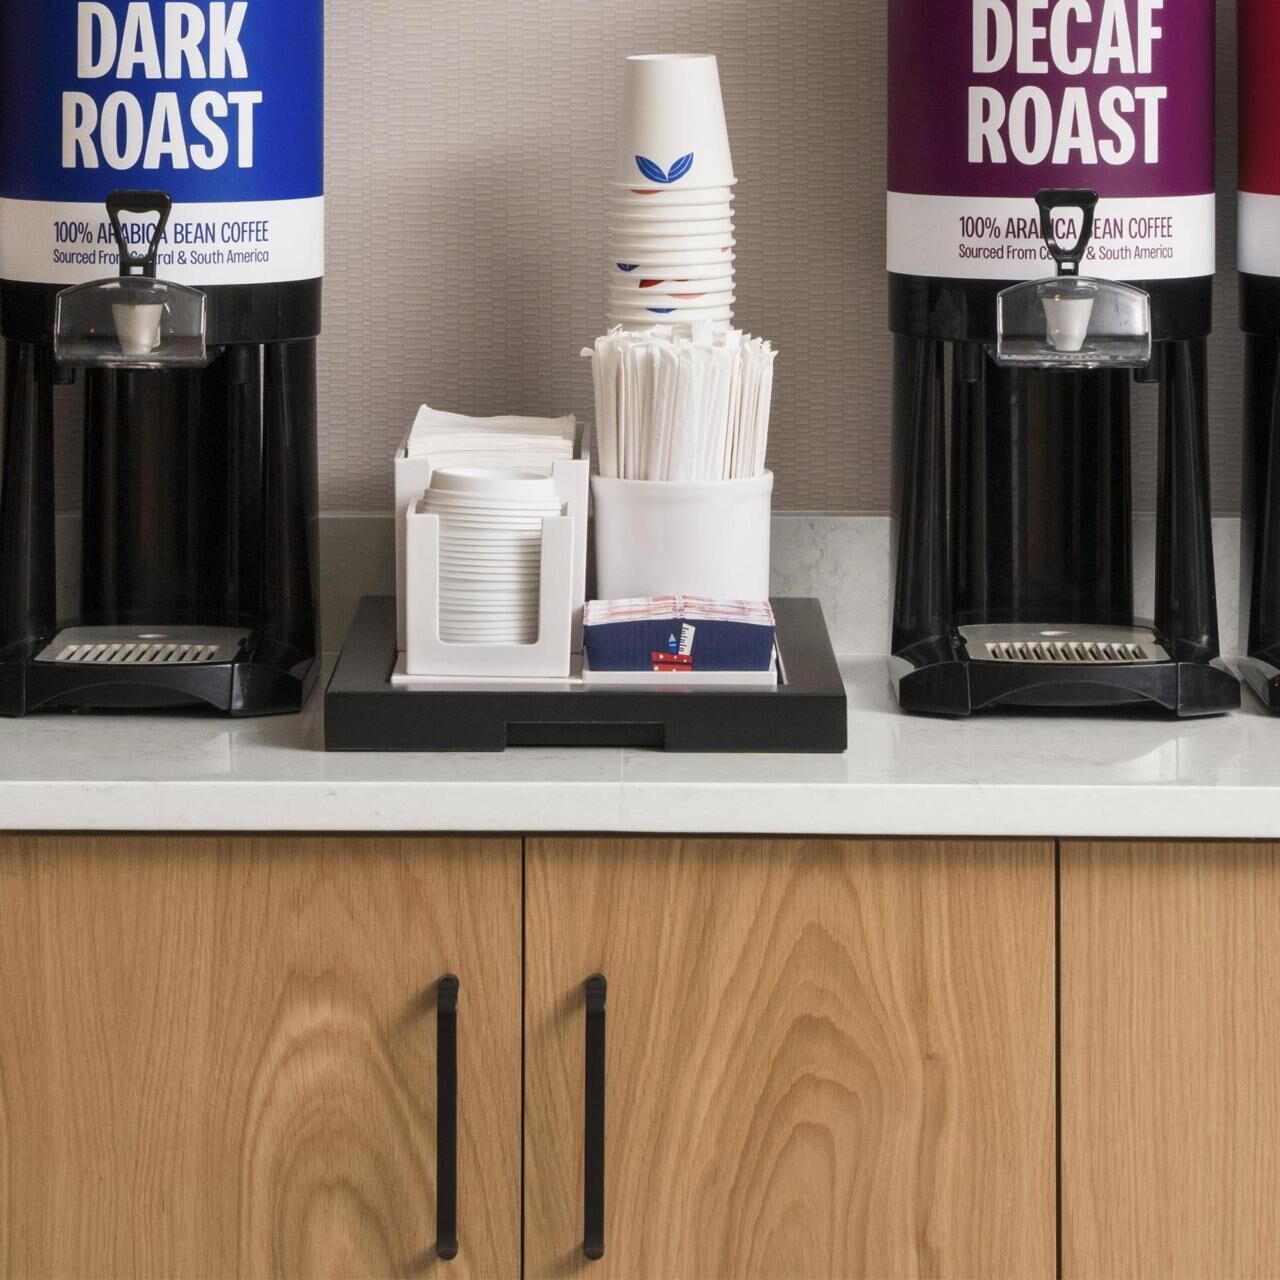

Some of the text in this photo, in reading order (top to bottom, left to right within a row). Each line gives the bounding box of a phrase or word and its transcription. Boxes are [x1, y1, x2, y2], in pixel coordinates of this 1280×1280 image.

[76, 1, 249, 79] DARK
[62, 90, 263, 171] ROAST
[968, 85, 1168, 166] ROAST
[53, 221, 93, 244] 100%
[173, 222, 216, 244] BEAN
[221, 220, 269, 243] COFFEE
[959, 216, 1174, 239] 100% ARAICA EAN COFFEE
[53, 248, 96, 265] Sourced
[177, 250, 187, 265] &
[190, 249, 224, 265] South
[226, 248, 269, 264] America
[958, 243, 1004, 260] Sourced
[1006, 244, 1037, 260] From
[1086, 245, 1096, 260] &
[1098, 244, 1132, 260] South
[1133, 243, 1174, 259] America
